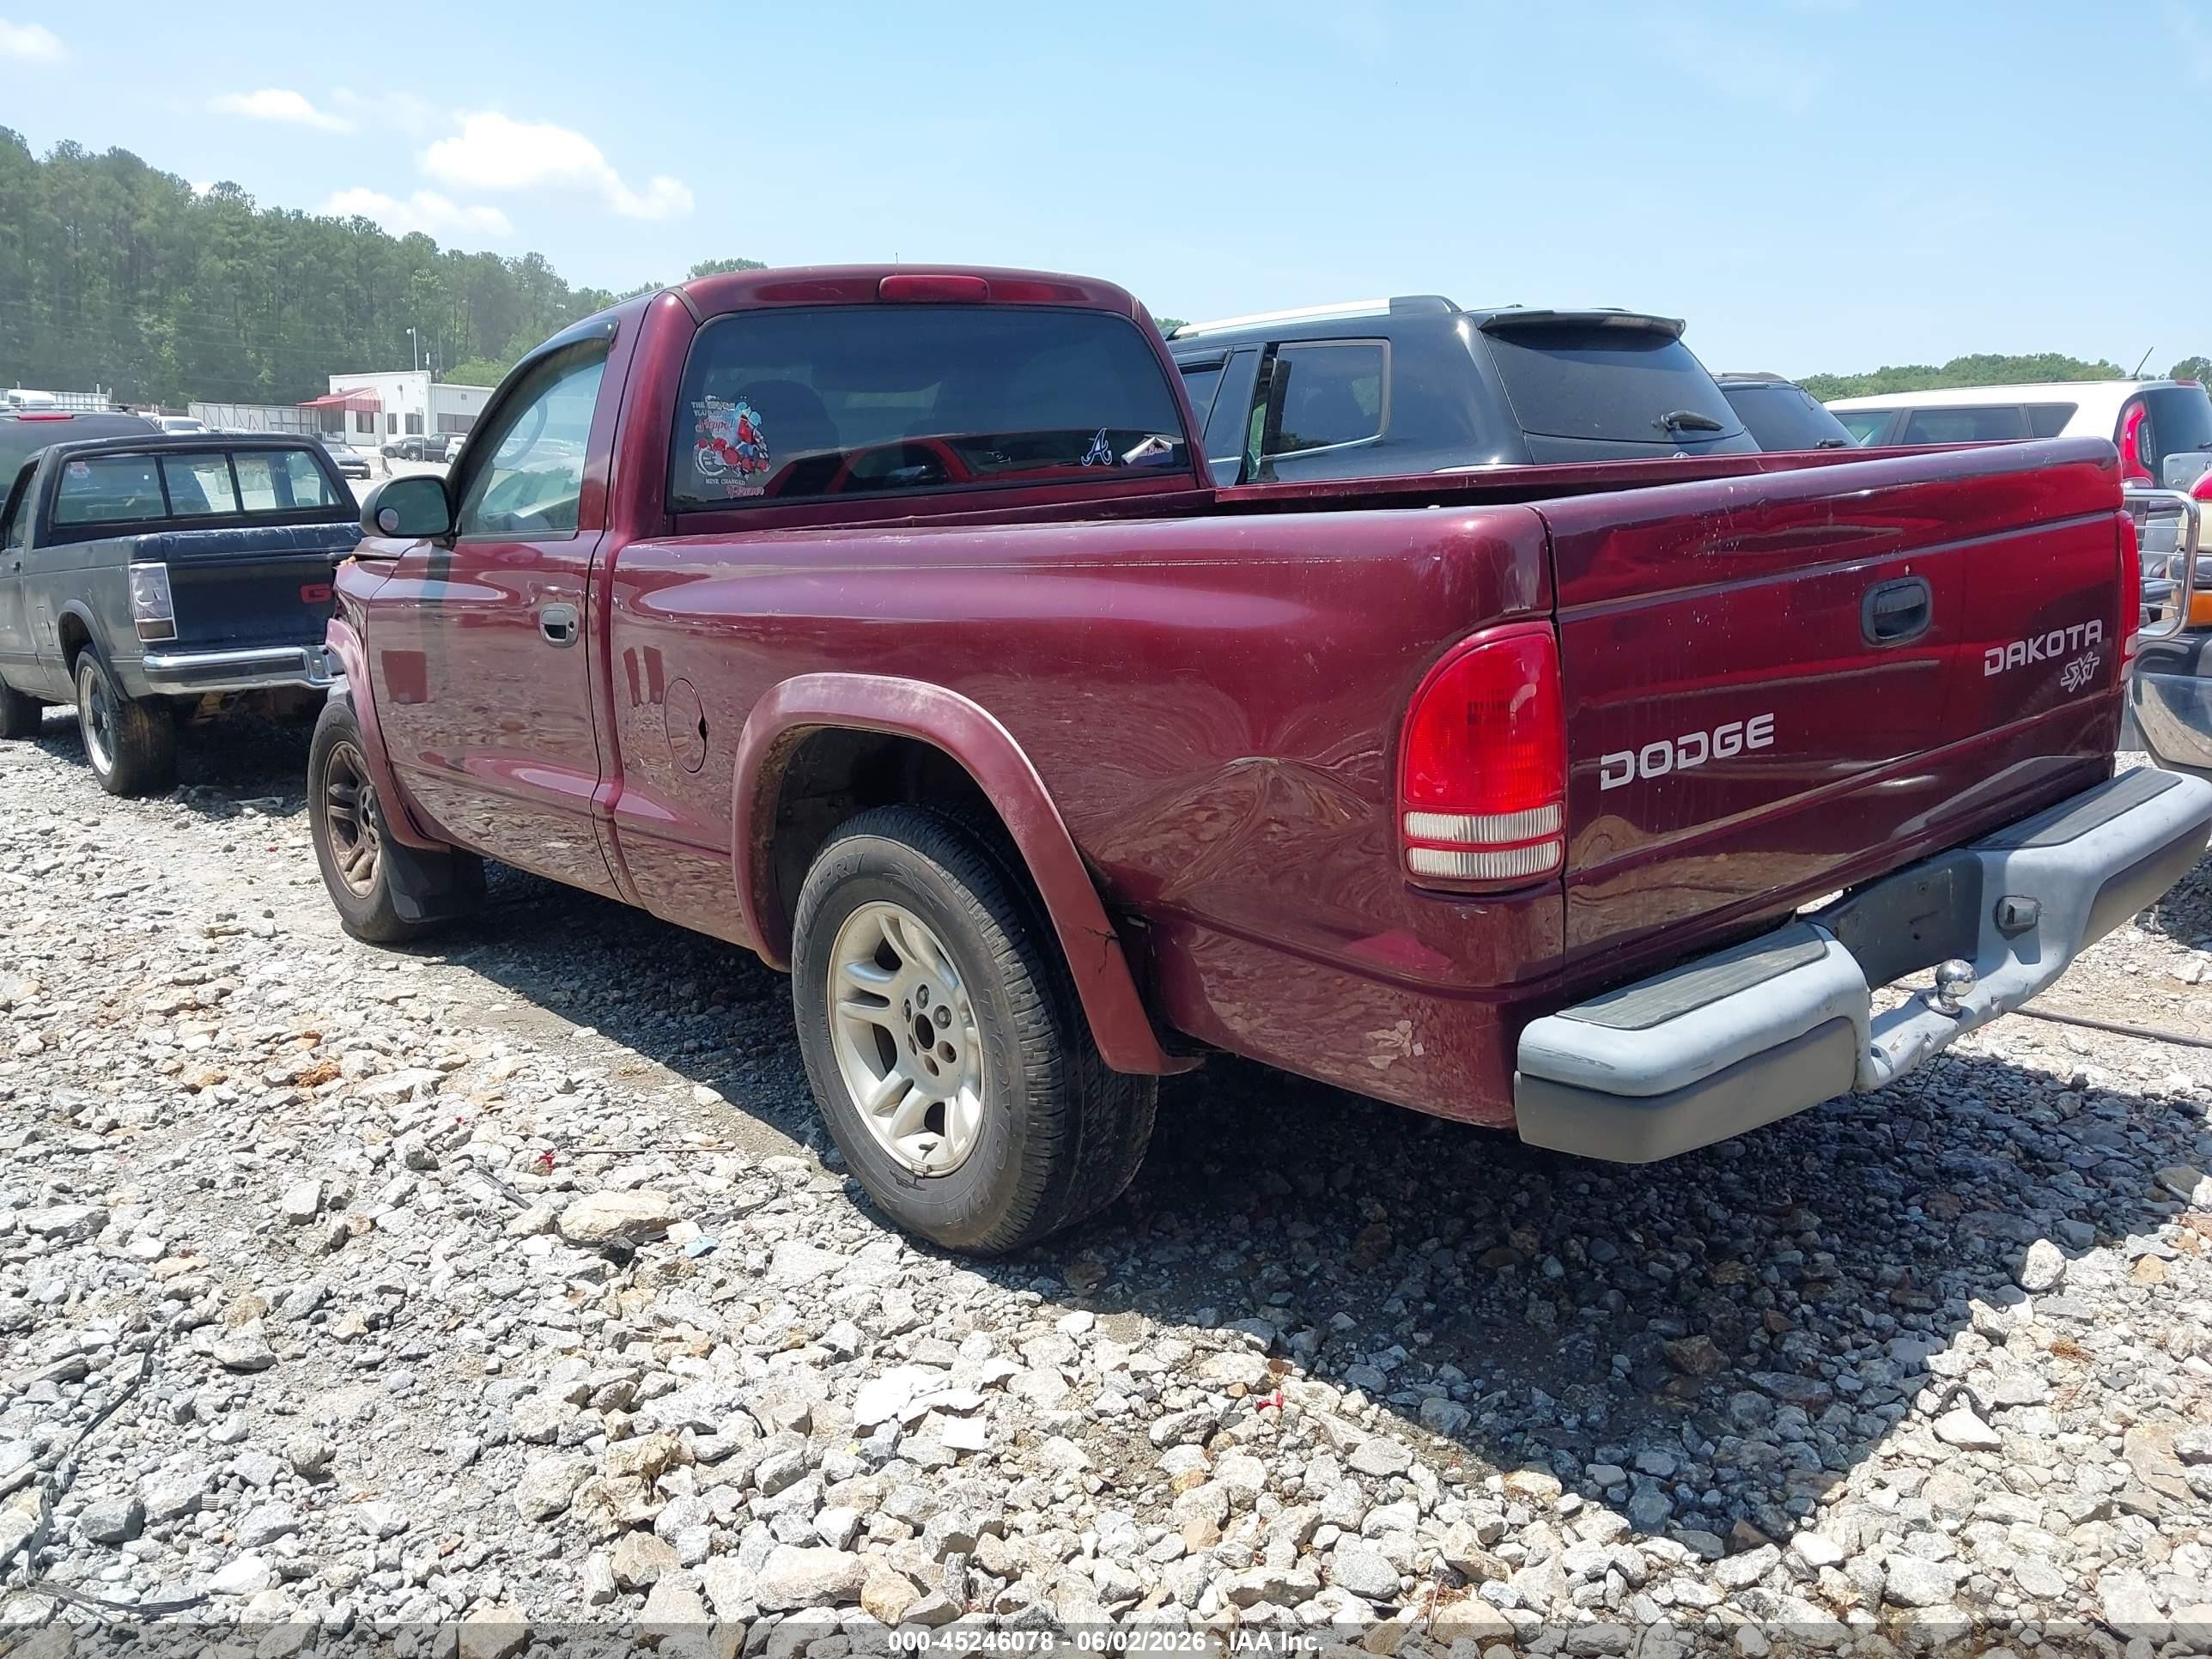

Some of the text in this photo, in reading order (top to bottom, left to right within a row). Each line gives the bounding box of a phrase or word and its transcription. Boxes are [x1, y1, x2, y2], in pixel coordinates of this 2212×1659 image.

[1984, 618, 2103, 677] DAKOTA
[2061, 651, 2100, 693] SXT
[1601, 713, 1774, 791] DODGE
